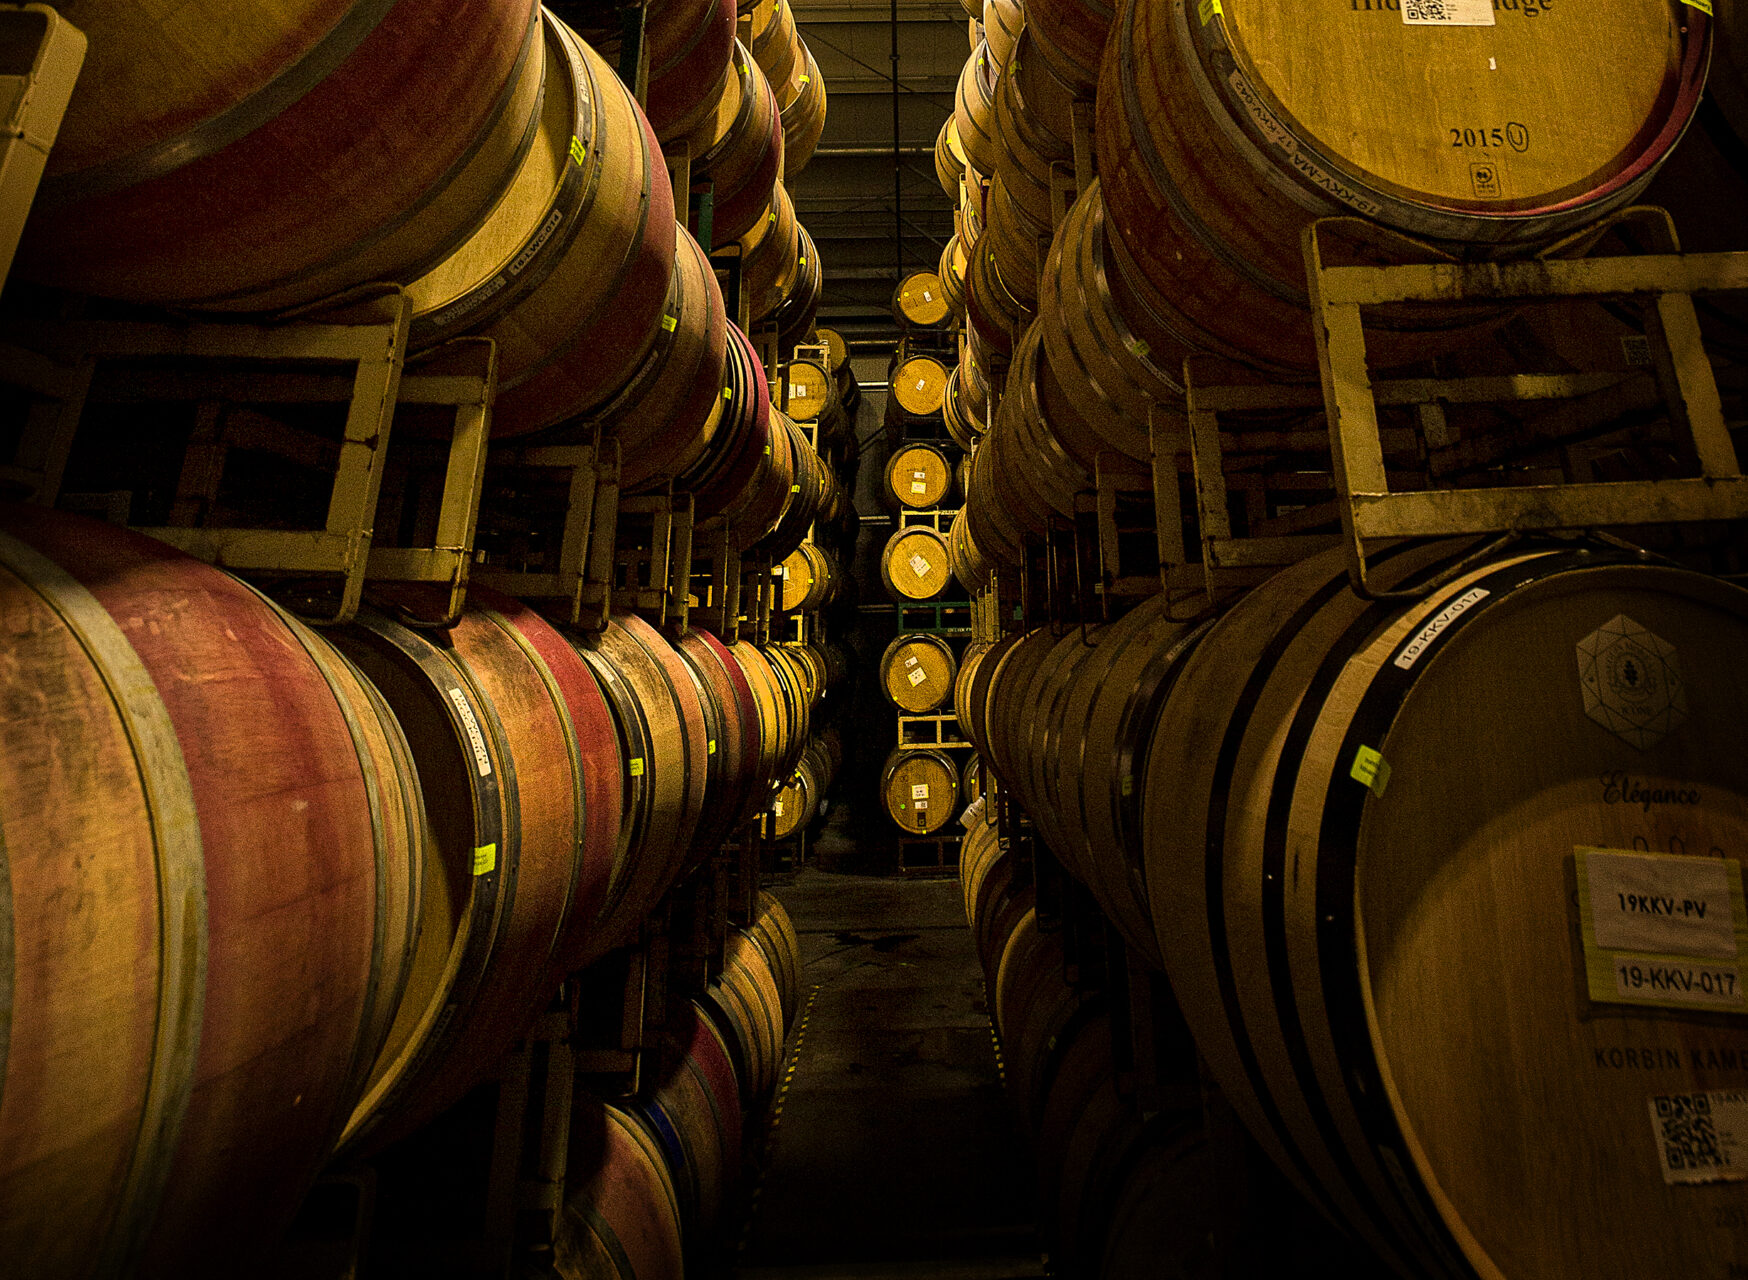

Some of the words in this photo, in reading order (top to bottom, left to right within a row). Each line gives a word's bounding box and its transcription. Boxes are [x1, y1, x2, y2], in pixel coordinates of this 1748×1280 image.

[1235, 80, 1292, 148] 17-KKV-042
[1449, 128, 1504, 147] 2015
[1293, 153, 1376, 215] 19-KKV-MA
[1402, 592, 1479, 662] 19-KKV-017
[1618, 893, 1706, 918] 19KKV-PV
[1620, 966, 1736, 995] 19-KKV-017
[1594, 1047, 1681, 1071] KORBIN
